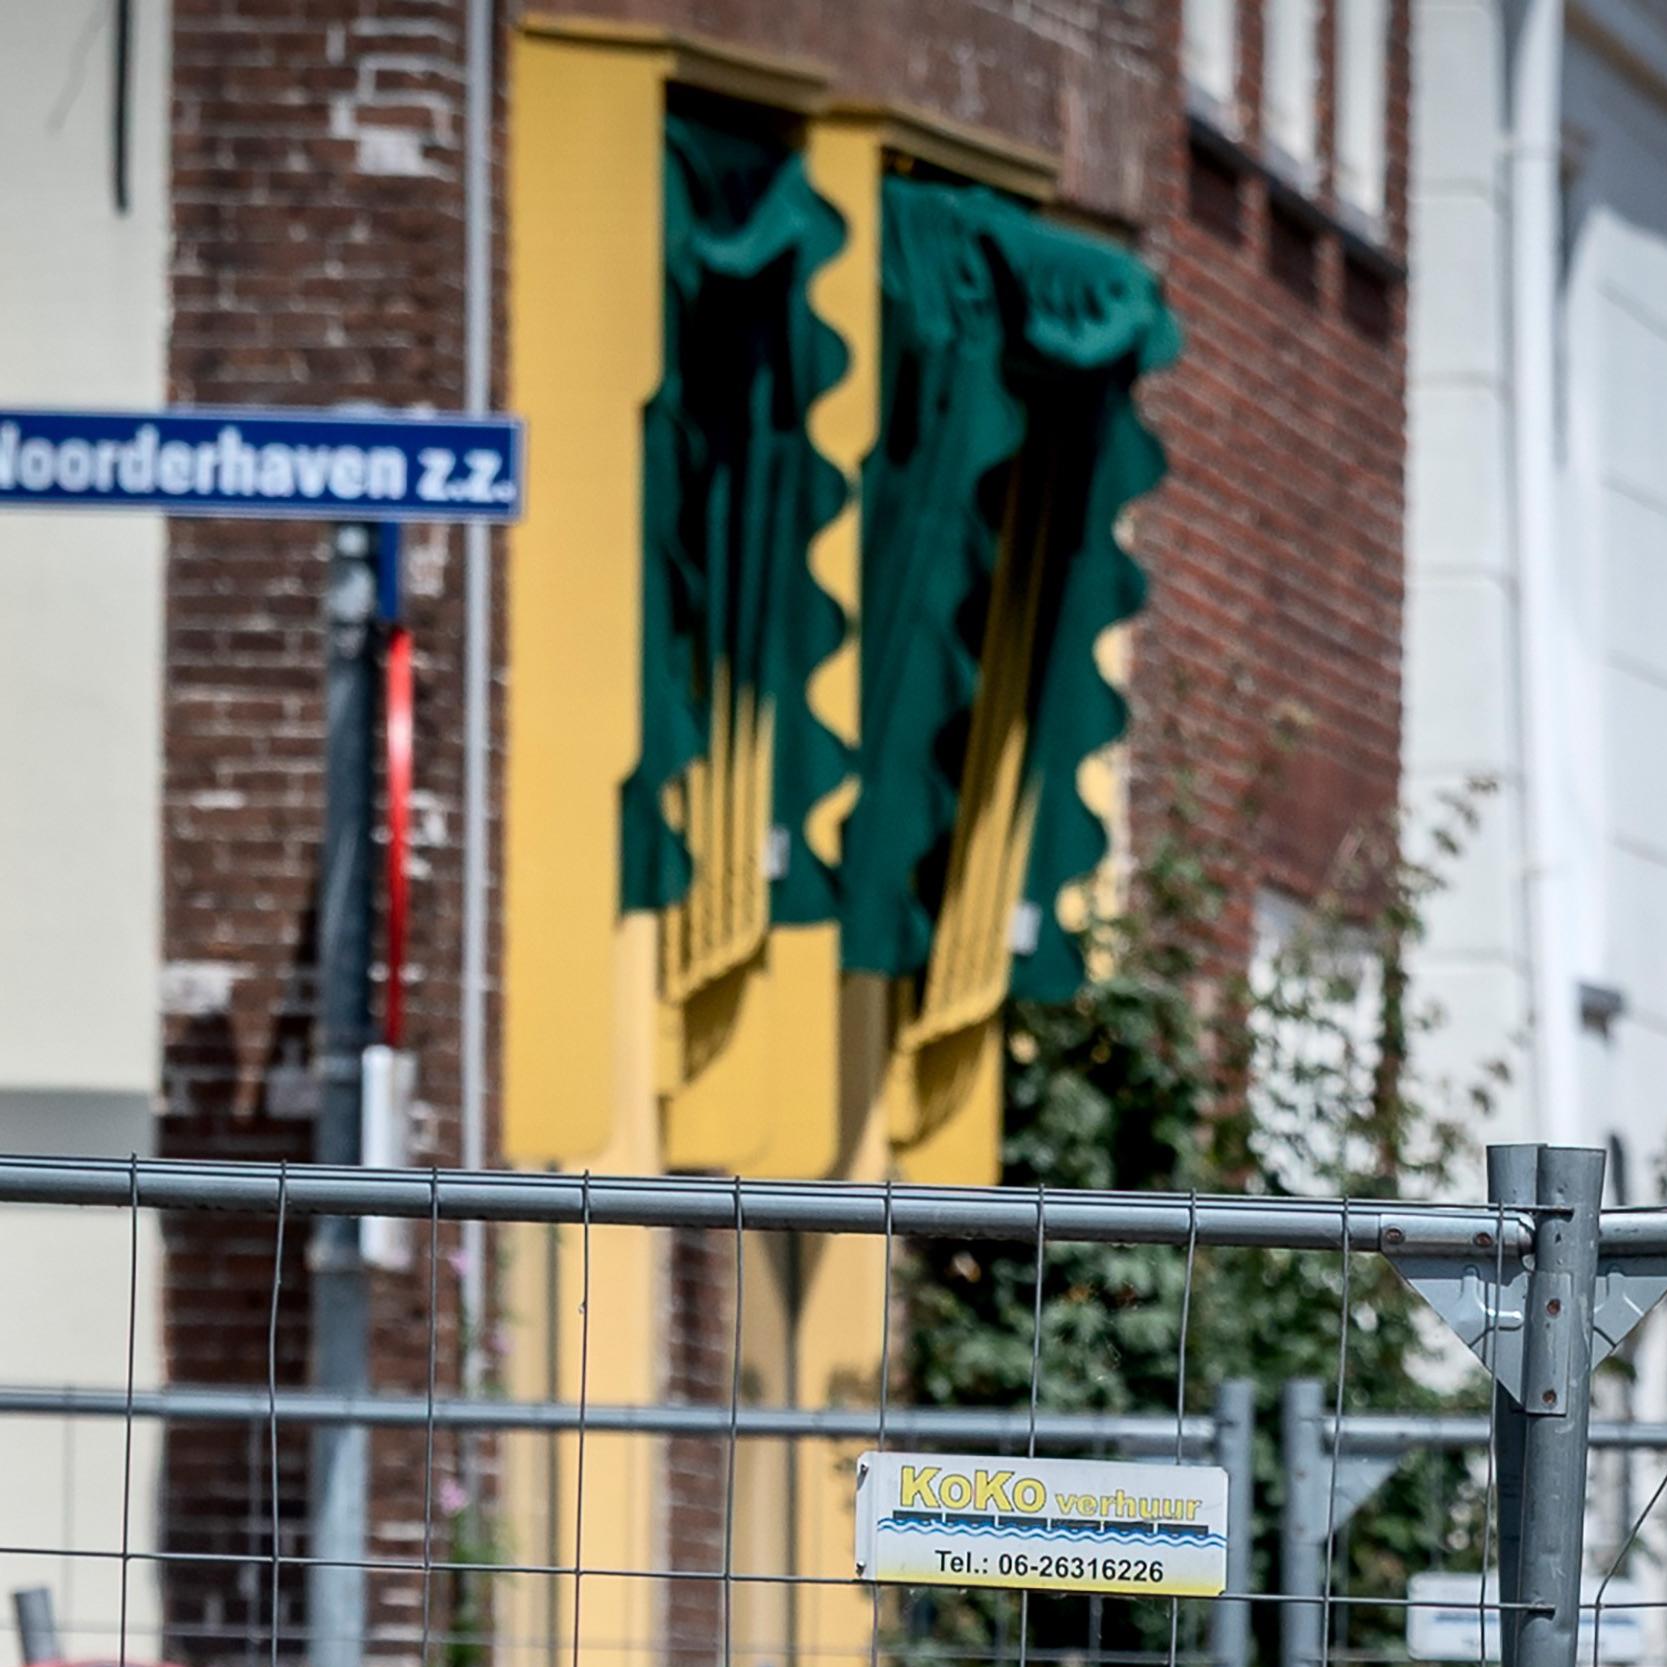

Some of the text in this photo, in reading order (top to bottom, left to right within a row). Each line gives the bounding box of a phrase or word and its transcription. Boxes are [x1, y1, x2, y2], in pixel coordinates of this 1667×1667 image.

[1055, 1489, 1203, 1521] verhuur
[934, 1550, 1165, 1583] Tel.: 06-26316226
